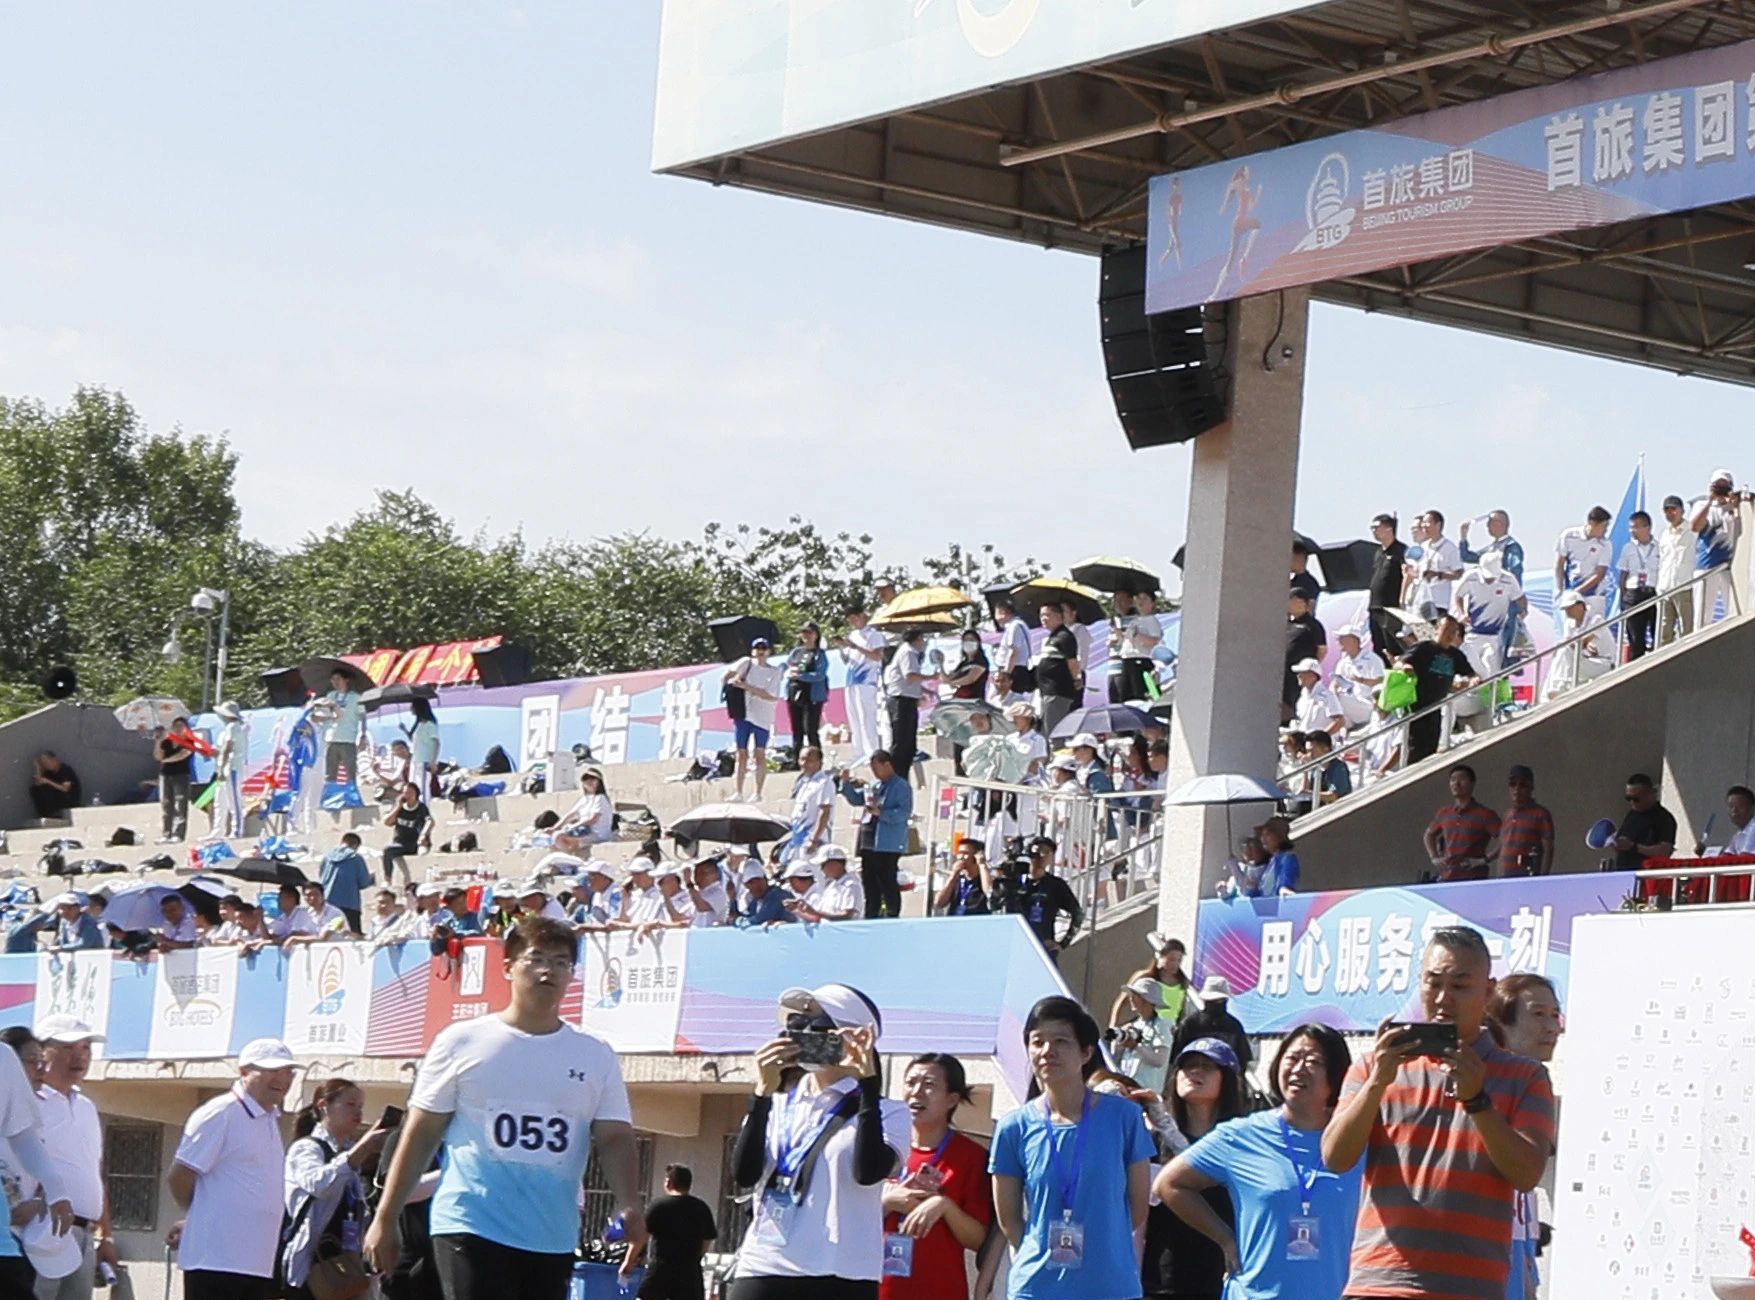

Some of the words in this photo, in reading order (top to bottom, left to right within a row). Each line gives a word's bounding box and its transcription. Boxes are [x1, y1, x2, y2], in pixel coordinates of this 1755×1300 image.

[1362, 149, 1473, 210] 首旅集团
[1363, 212, 1396, 230] BEIJING
[1398, 204, 1438, 222] TOURISM
[1440, 195, 1474, 213] GROUP
[1316, 226, 1342, 244] BTG
[521, 678, 702, 772] 团结拼
[627, 965, 678, 989] 首旅集团
[494, 1113, 569, 1153] 053
